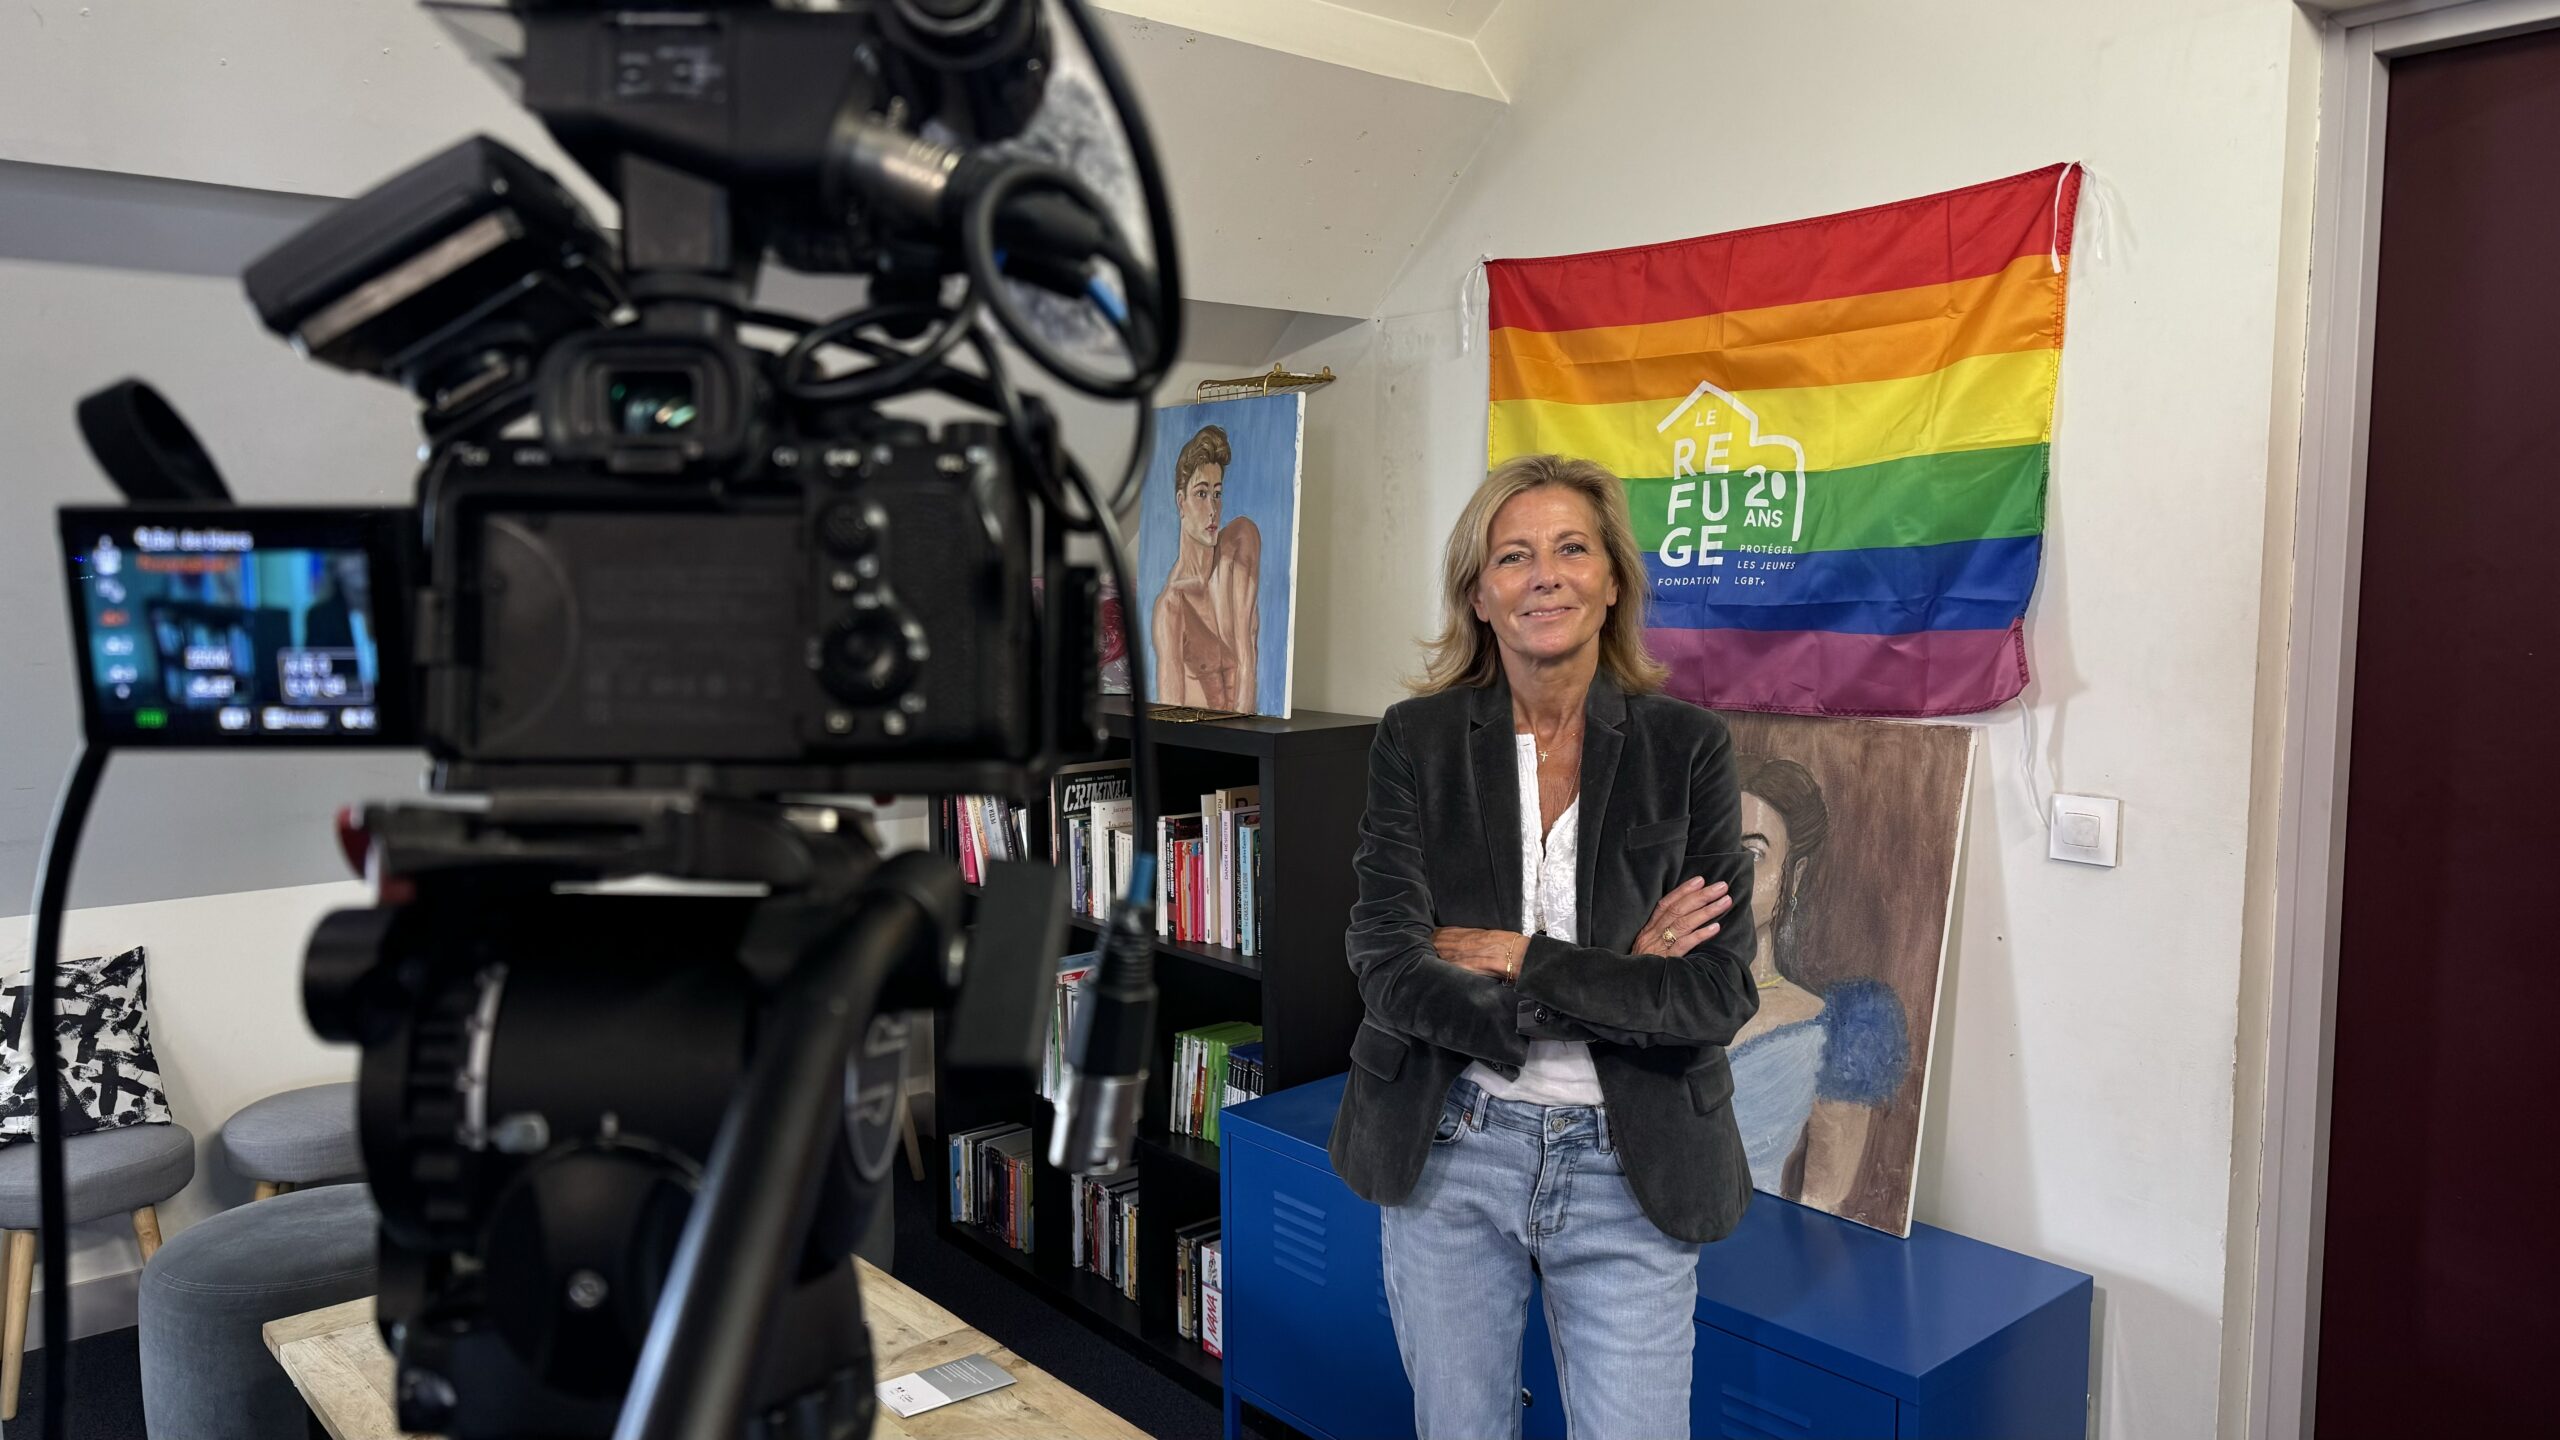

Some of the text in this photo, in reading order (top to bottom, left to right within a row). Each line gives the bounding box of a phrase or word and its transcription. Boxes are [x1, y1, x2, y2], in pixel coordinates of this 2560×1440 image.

[1695, 410, 1717, 427] LE
[1674, 432, 1733, 480] RE
[1743, 465, 1787, 508] 20
[1667, 479, 1730, 526] FU
[1744, 509, 1783, 528] ANS
[1659, 525, 1727, 567] GE
[1740, 543, 1793, 555] PROTÉGER
[1737, 560, 1796, 570] LES JEUNES
[1657, 575, 1720, 586] FONDATION
[1734, 576, 1766, 586] LGBT+
[1063, 780, 1127, 812] CRIMINAL
[1206, 1293, 1218, 1342] NANA
